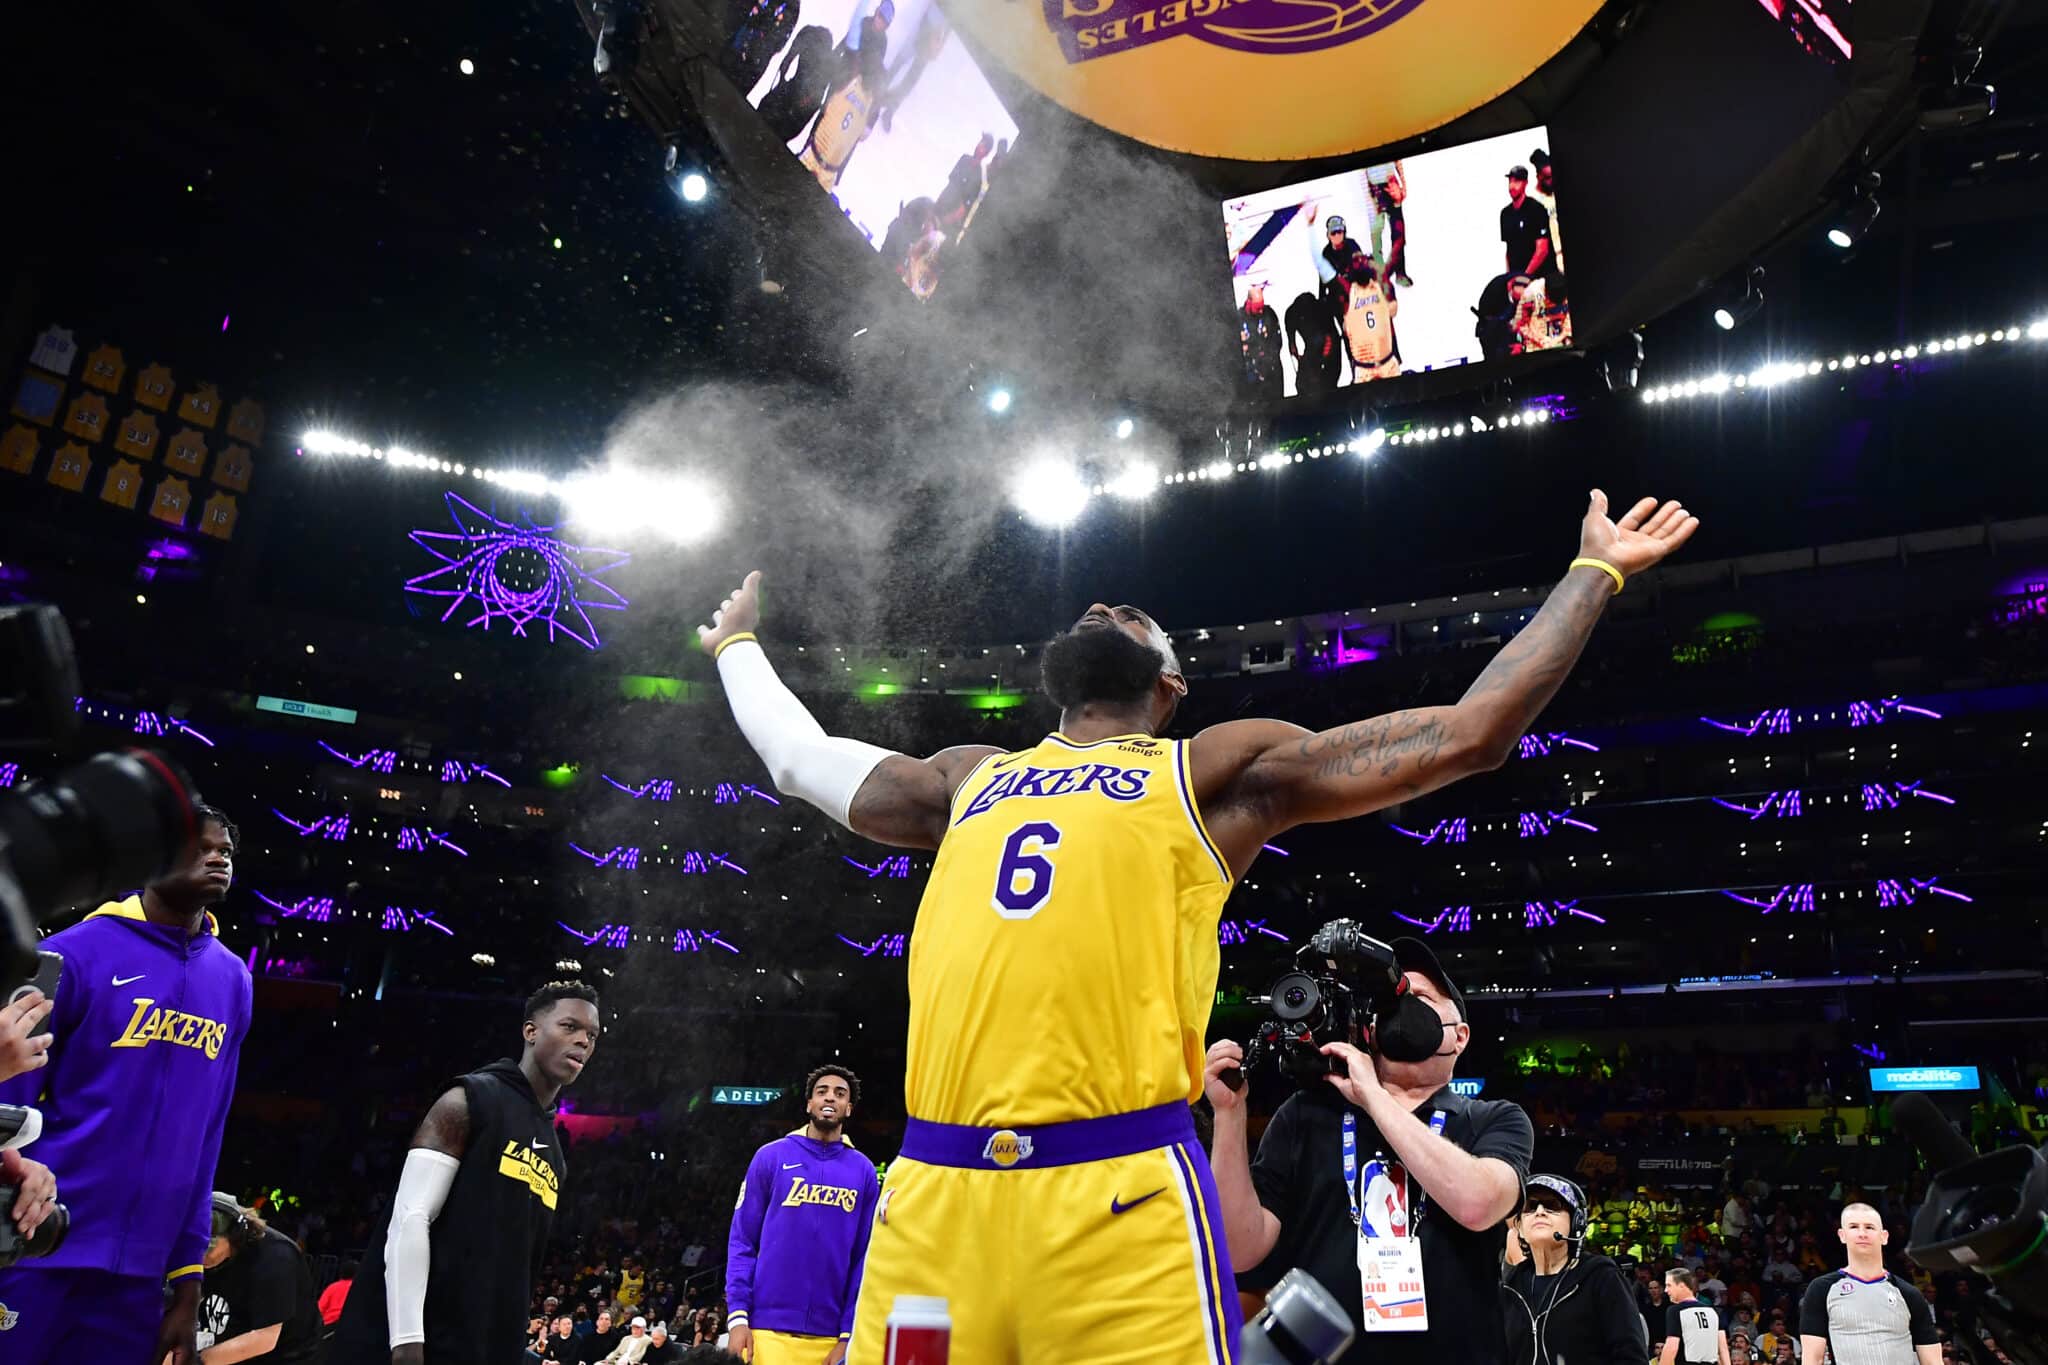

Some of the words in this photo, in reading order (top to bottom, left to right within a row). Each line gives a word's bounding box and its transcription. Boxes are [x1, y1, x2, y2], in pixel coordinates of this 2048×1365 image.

[1077, 0, 1232, 49] GELES
[1366, 311, 1376, 329] 6
[117, 479, 129, 492] 8
[1117, 745, 1164, 757] bibigo
[953, 763, 1153, 827] LAKERS
[991, 820, 1062, 920] 6
[110, 998, 227, 1060] LAKERS
[1886, 1069, 1962, 1083] mobilitie
[1638, 1159, 1675, 1169] ESPN
[781, 1177, 858, 1213] LAKERS
[1694, 1311, 1709, 1329] 16
